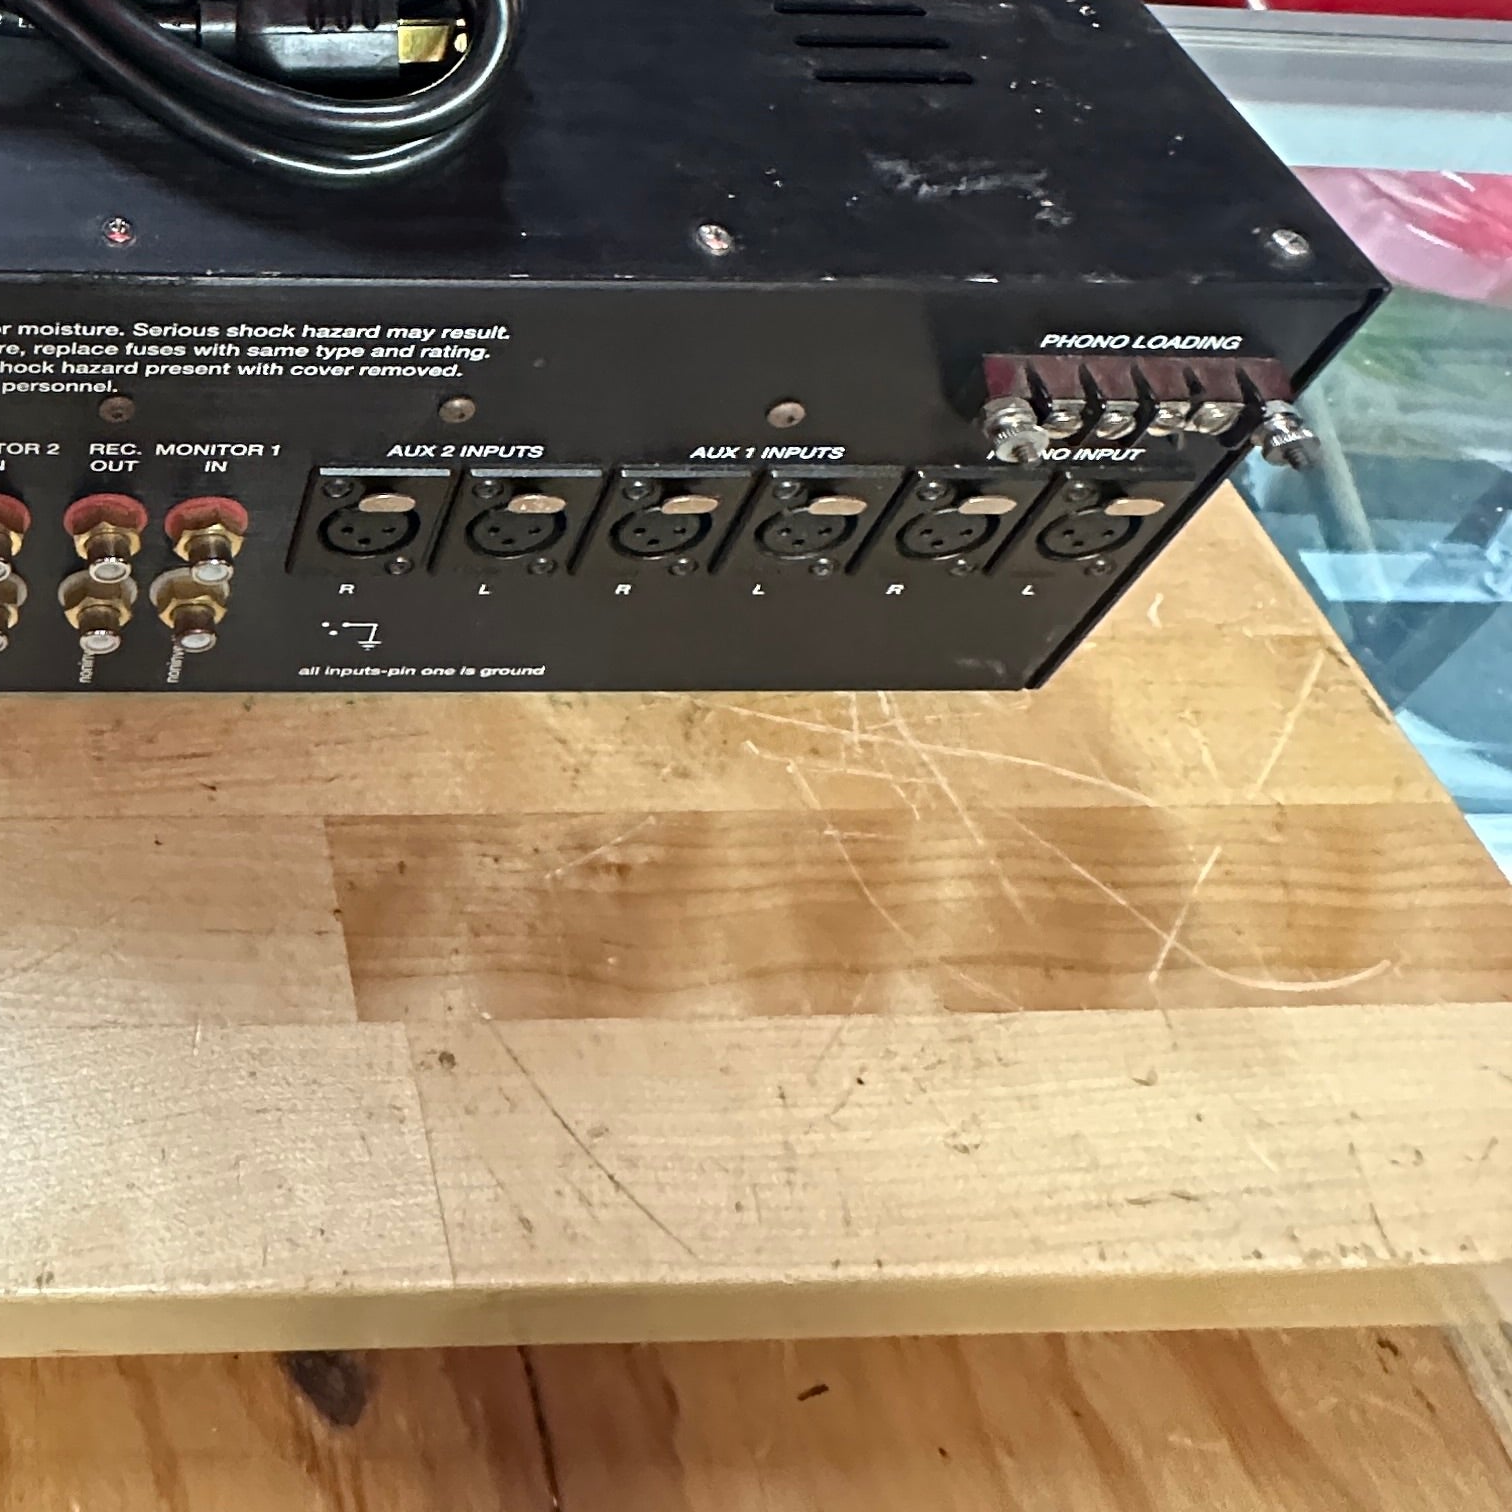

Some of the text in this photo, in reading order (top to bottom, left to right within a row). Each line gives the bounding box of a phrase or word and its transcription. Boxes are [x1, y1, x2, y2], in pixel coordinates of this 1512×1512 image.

[17, 322, 126, 337] moisture.
[134, 323, 220, 338] Serious
[226, 323, 296, 338] shock
[301, 324, 382, 340] hazard
[385, 329, 438, 344] may
[440, 326, 511, 340] result.
[1039, 333, 1244, 351] PHONO LOADING
[33, 341, 120, 359] replace
[124, 341, 187, 355] fuses
[193, 342, 241, 356] with
[246, 345, 310, 357] same
[315, 344, 366, 361] type
[369, 344, 417, 358] and
[419, 344, 491, 362] rating.
[61, 360, 139, 375] hazard
[144, 362, 232, 378] present
[236, 362, 284, 376] with
[289, 365, 355, 377] cover
[358, 363, 464, 378] removed.
[1, 379, 119, 396] personnel.
[46, 442, 61, 456] 2
[89, 442, 143, 456] REC.
[155, 443, 281, 457] MONITOR 1
[386, 444, 545, 459] AUX 2 INPUTS
[689, 446, 846, 460] AUX 1 INPUTS
[1071, 447, 1147, 462] INPUT
[89, 459, 141, 473] OUT
[204, 460, 229, 473] IN
[338, 583, 355, 595] R
[478, 583, 491, 596] L
[614, 583, 632, 596] R
[751, 583, 766, 596] L
[885, 583, 905, 595] R
[1021, 584, 1035, 596] L
[297, 664, 546, 678] all inputs-pin one is ground
